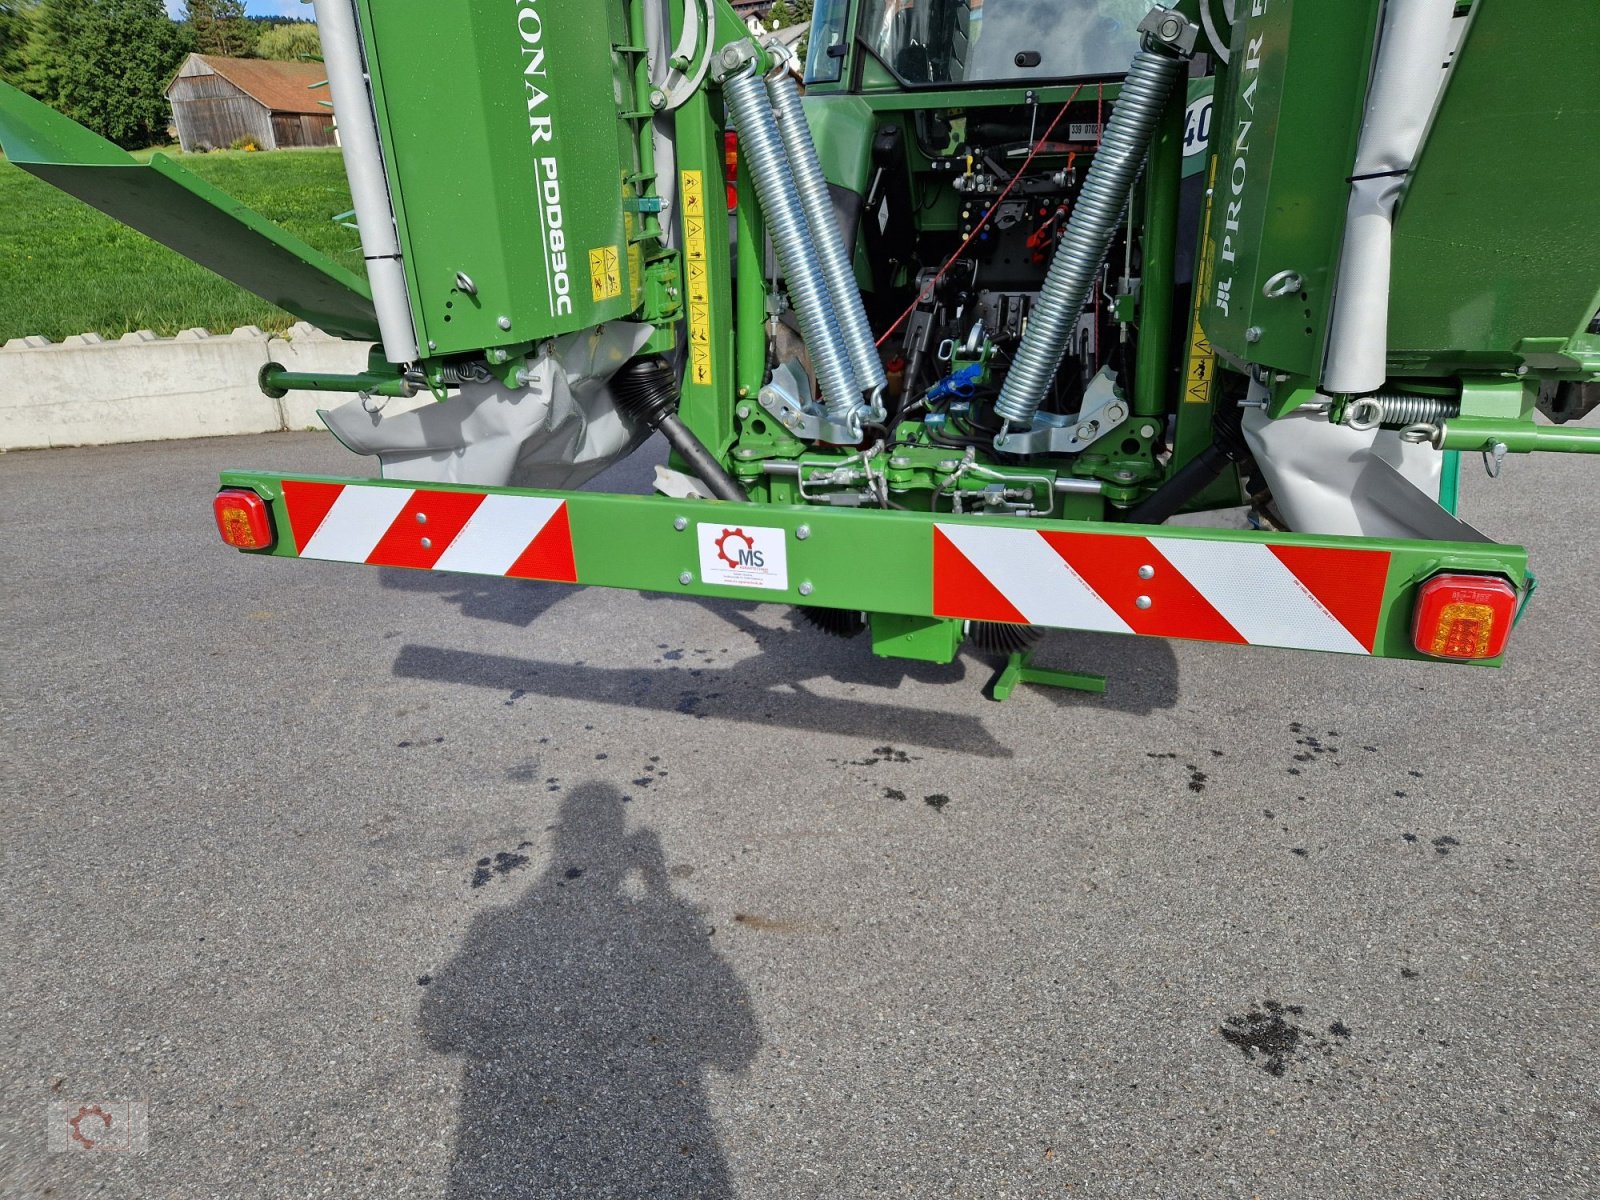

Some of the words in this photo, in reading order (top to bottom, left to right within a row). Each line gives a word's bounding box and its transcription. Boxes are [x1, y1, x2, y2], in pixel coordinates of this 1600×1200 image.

[515, 0, 552, 146] ONAR
[1222, 34, 1263, 266] PRONAR
[541, 157, 573, 315] PDD830C
